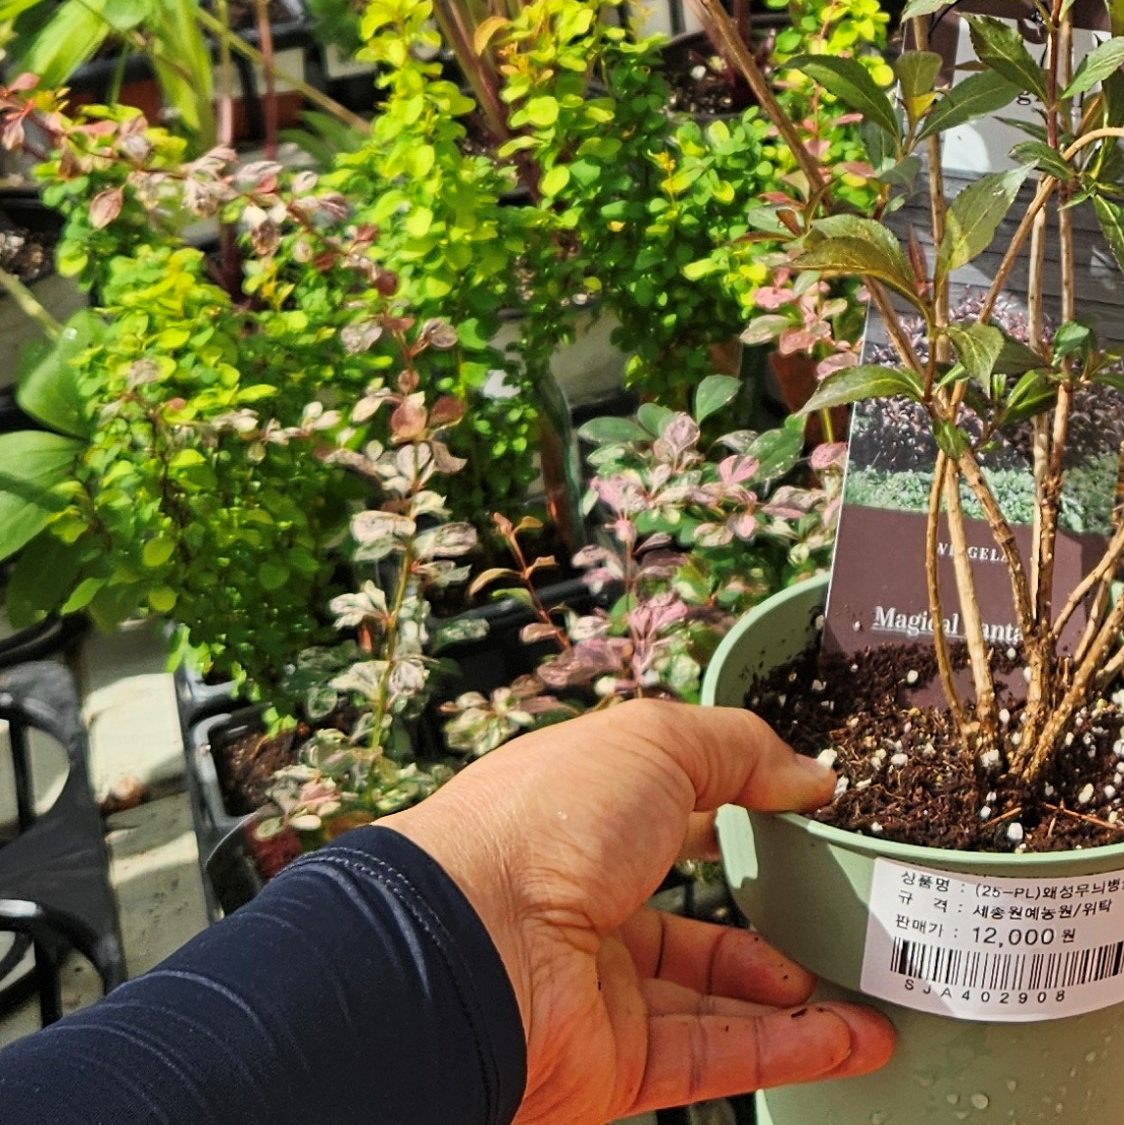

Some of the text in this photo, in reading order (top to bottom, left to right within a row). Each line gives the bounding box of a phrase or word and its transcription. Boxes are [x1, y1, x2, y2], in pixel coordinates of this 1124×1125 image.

[901, 870, 951, 893] 상품명
[895, 913, 945, 938] 판매가
[972, 926, 1055, 949] 12,000
[1062, 927, 1077, 944] 원
